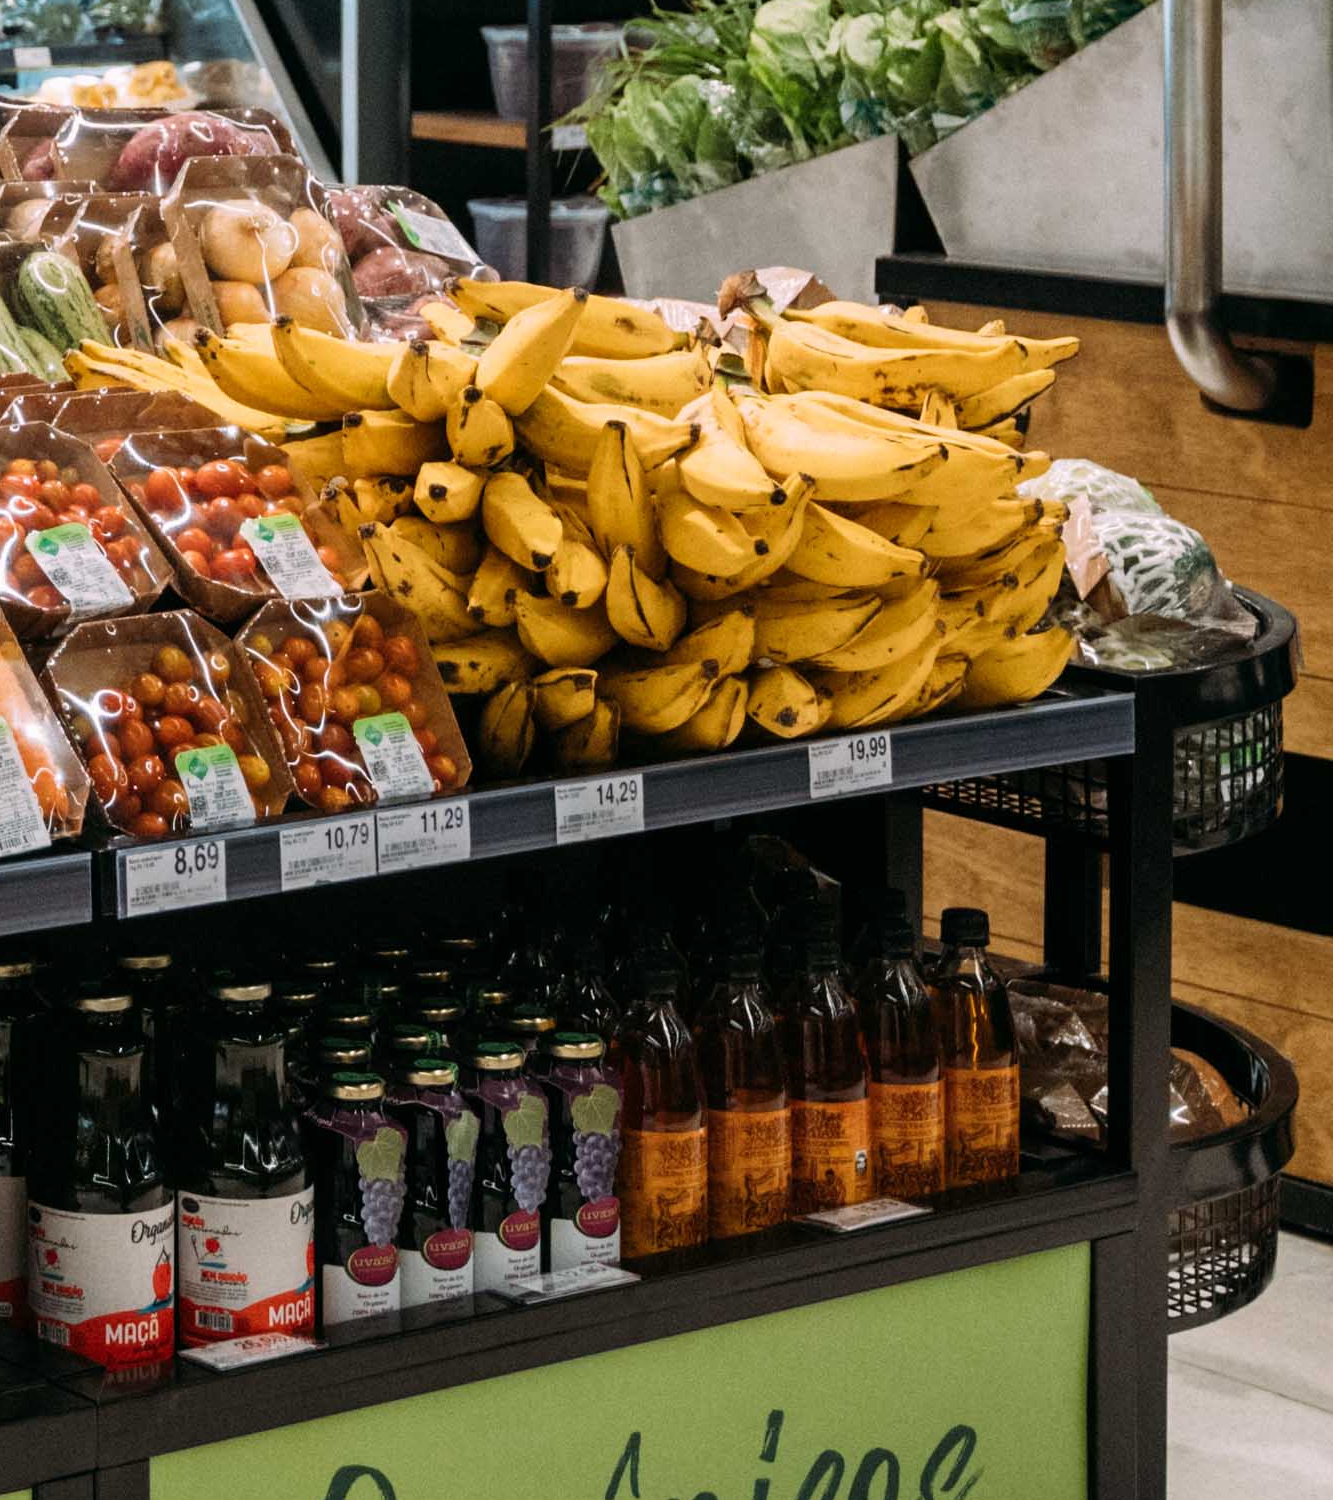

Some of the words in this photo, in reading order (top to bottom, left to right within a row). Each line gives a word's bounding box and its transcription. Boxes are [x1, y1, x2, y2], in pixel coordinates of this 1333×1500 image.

[846, 734, 888, 762] 19,99
[595, 777, 639, 808] 14,29
[420, 805, 465, 836] 11,29
[323, 821, 370, 853] 10,79
[174, 842, 220, 879] 8,69
[268, 1291, 312, 1328] MAÇÃ
[105, 1315, 159, 1348] MAÇÃ
